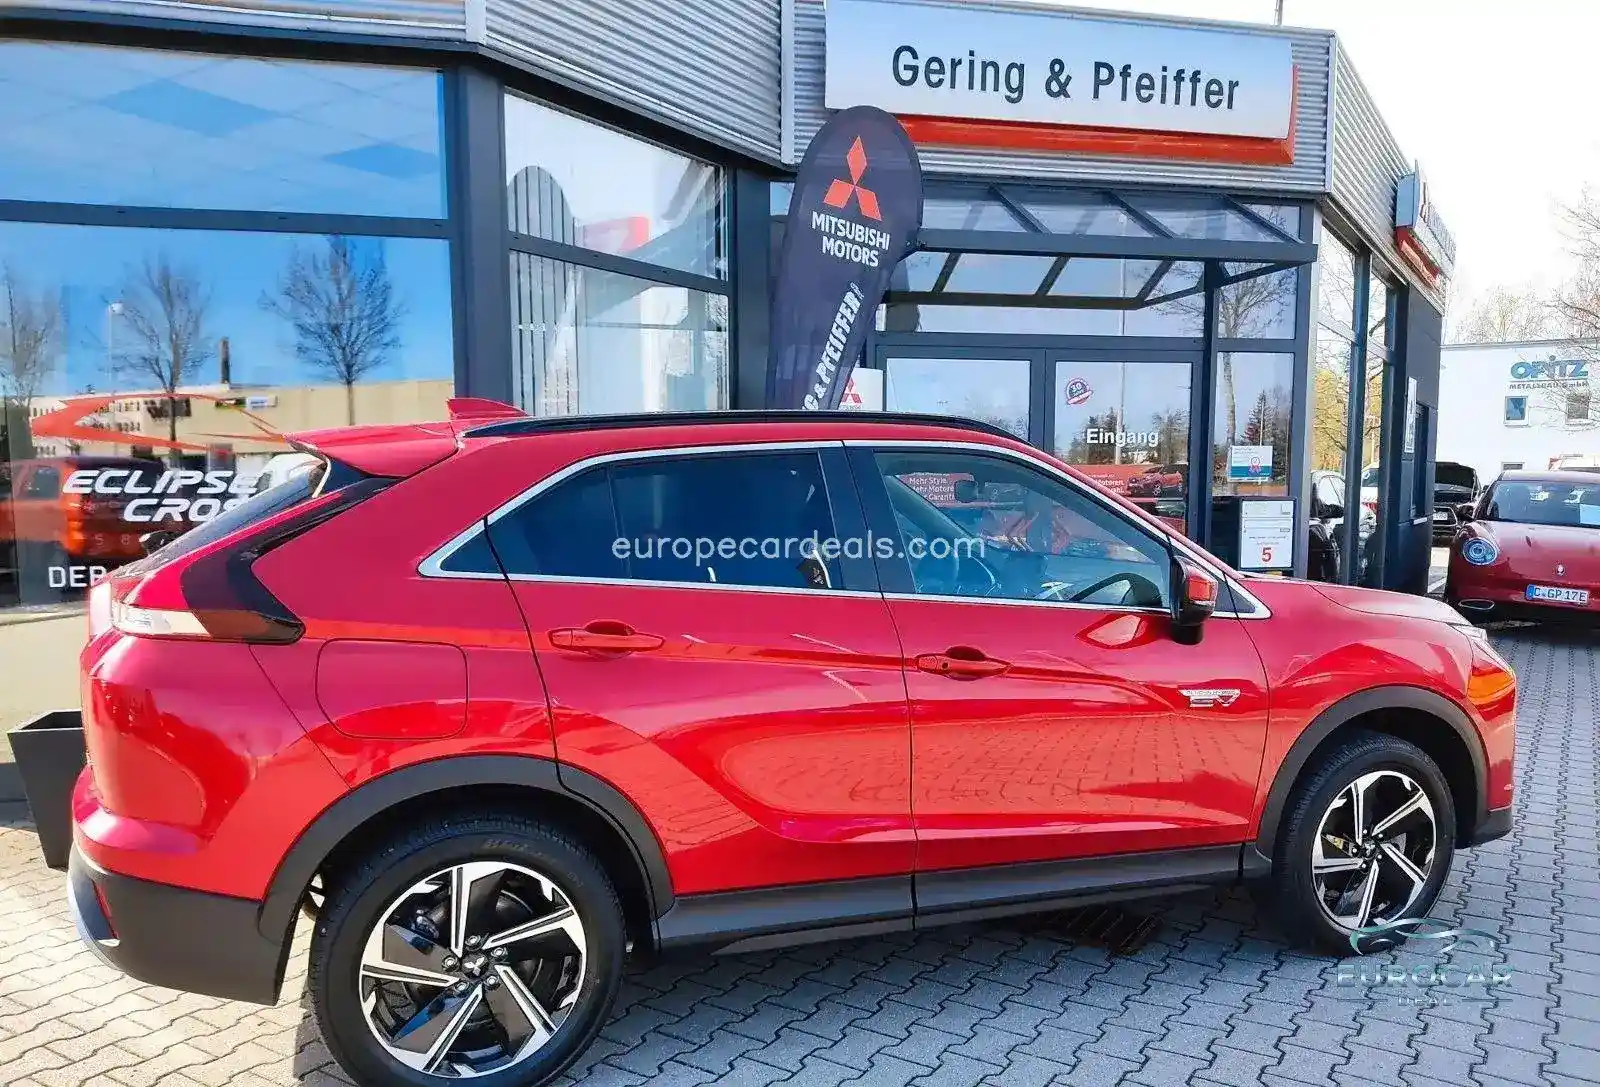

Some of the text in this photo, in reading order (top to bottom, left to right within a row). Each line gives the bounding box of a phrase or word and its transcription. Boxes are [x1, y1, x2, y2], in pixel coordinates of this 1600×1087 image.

[892, 45, 1239, 110] Gering & Pfeiffer
[811, 211, 890, 250] MITSUBISHI
[822, 235, 879, 267] MOTORS
[816, 291, 861, 385] PFEIFFER
[1086, 429, 1159, 447] Eingang
[62, 470, 258, 494] ECLIPSE
[1261, 547, 1272, 562] 5
